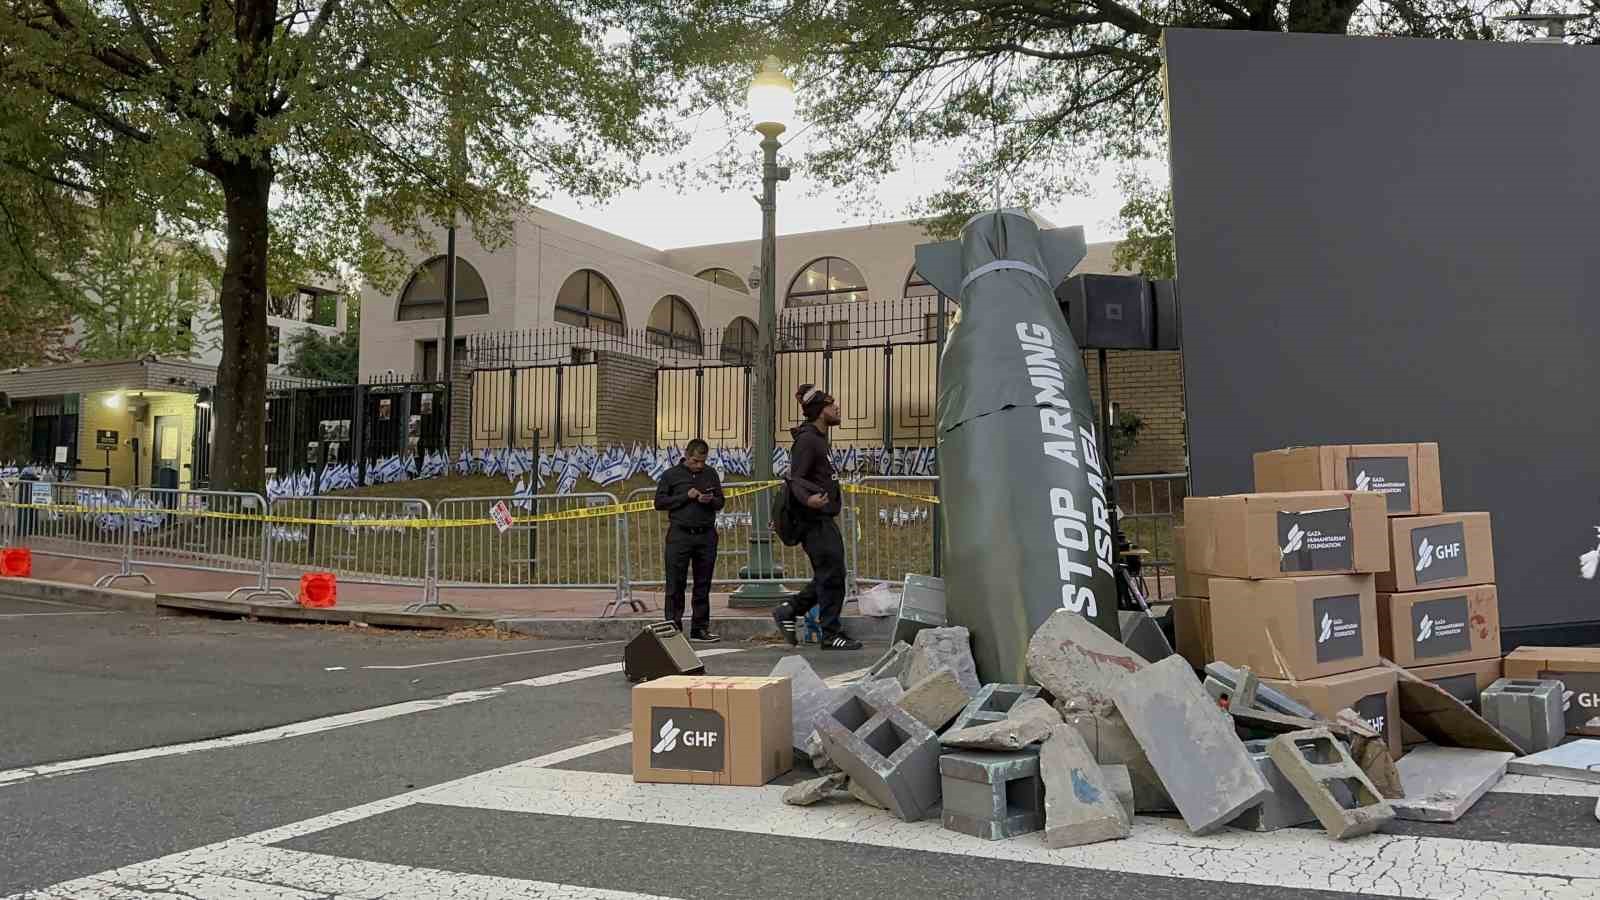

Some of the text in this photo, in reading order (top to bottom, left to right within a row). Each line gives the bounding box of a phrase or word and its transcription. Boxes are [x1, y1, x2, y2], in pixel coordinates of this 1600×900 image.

[1015, 322, 1098, 617] STOP ARMING
[1079, 422, 1114, 578] ISRAEL
[1306, 535, 1346, 543] HUMANITARIAN
[1307, 542, 1342, 550] FOUNDATION
[1435, 543, 1461, 559] GHF
[682, 730, 718, 747] GHF
